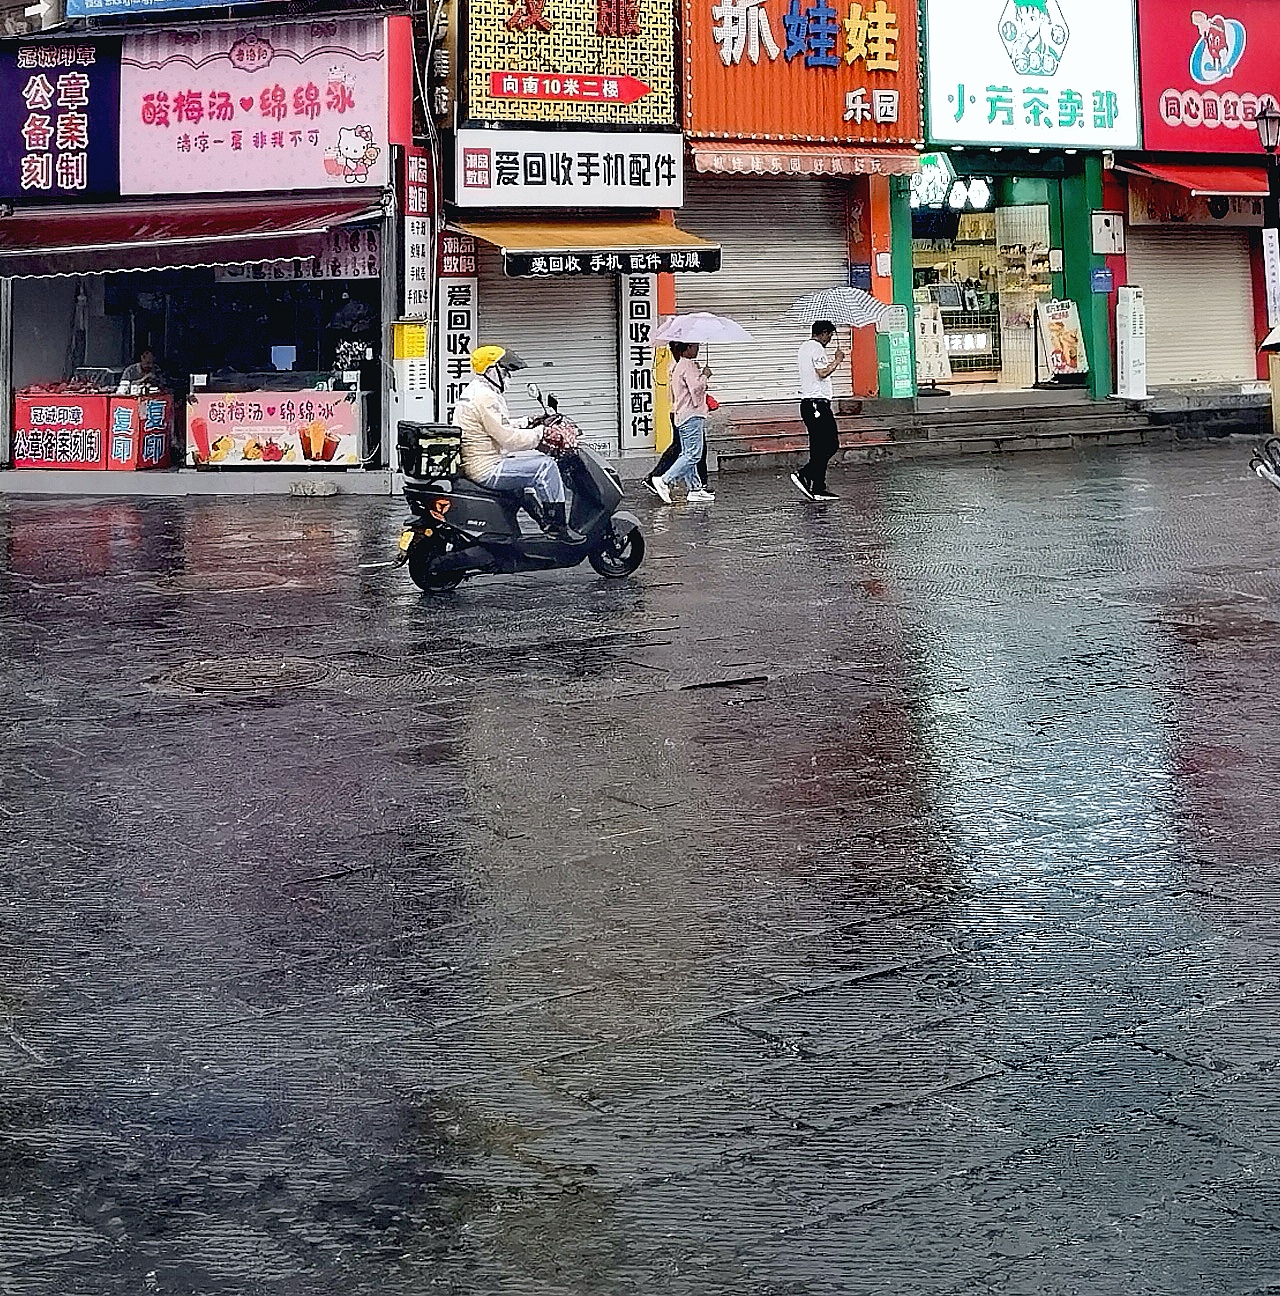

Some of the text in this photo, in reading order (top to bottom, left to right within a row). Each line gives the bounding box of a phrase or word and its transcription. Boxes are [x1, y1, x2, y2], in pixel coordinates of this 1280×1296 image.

[22, 72, 90, 110] 公章
[142, 81, 356, 127] 酸梅汤 绵绵冰
[502, 75, 620, 99] 向南10米二楼
[843, 87, 899, 125] 乐园
[947, 83, 1119, 129] 小芳茶卖部
[1165, 91, 1277, 122] 同心圆红豆
[21, 113, 89, 150] 备案
[177, 129, 320, 152] 清凉一夏 非我不可
[21, 153, 88, 190] 刻制
[495, 150, 677, 187] 爱回收手机配件
[531, 251, 701, 273] 爱回收 手机 配件 贴膜
[629, 275, 654, 438] 爱回收手机配件
[209, 399, 335, 424] 酸梅汤 绵绵冰
[14, 427, 102, 464] 公章备案刻制
[111, 406, 134, 463] 复印
[143, 399, 167, 464] 复印
